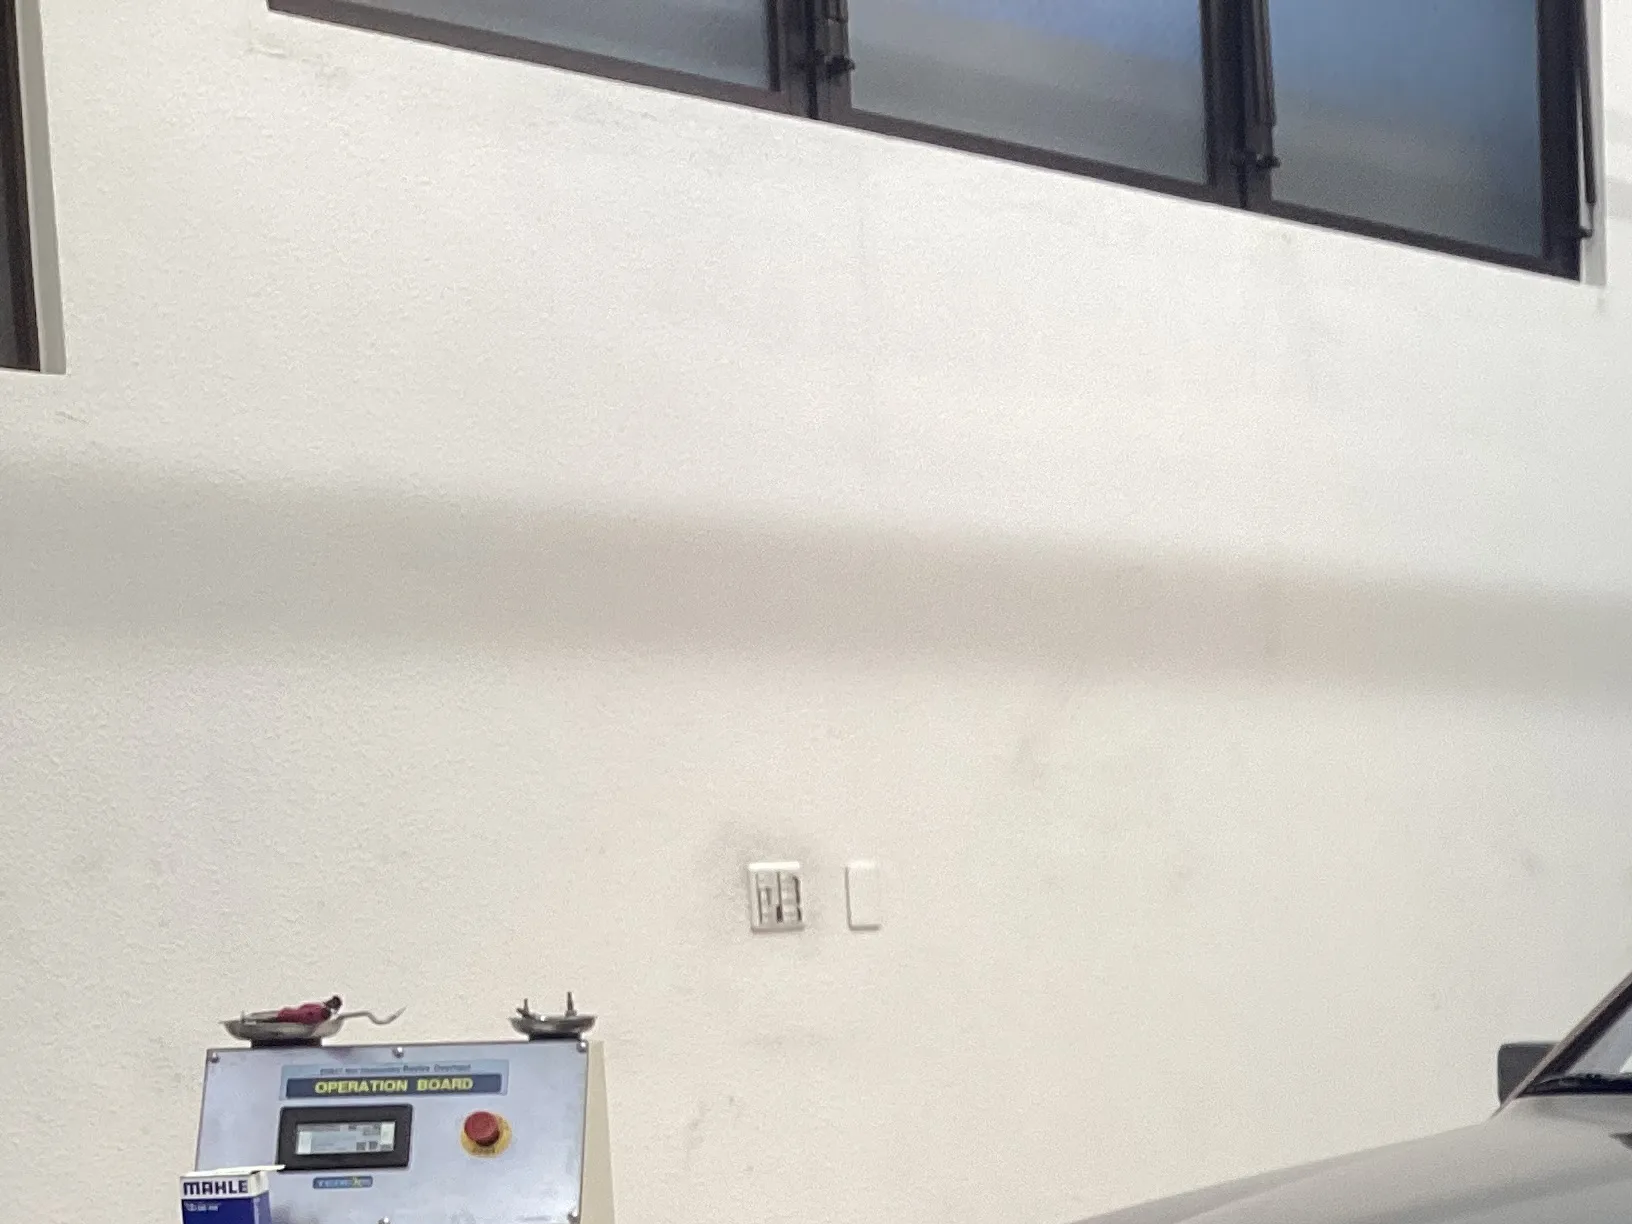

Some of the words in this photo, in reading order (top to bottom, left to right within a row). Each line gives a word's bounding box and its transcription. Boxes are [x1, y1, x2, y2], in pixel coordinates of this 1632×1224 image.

[315, 1080, 408, 1094] OPERATION
[417, 1077, 474, 1091] BOARD
[183, 1179, 248, 1196] MAHLE
